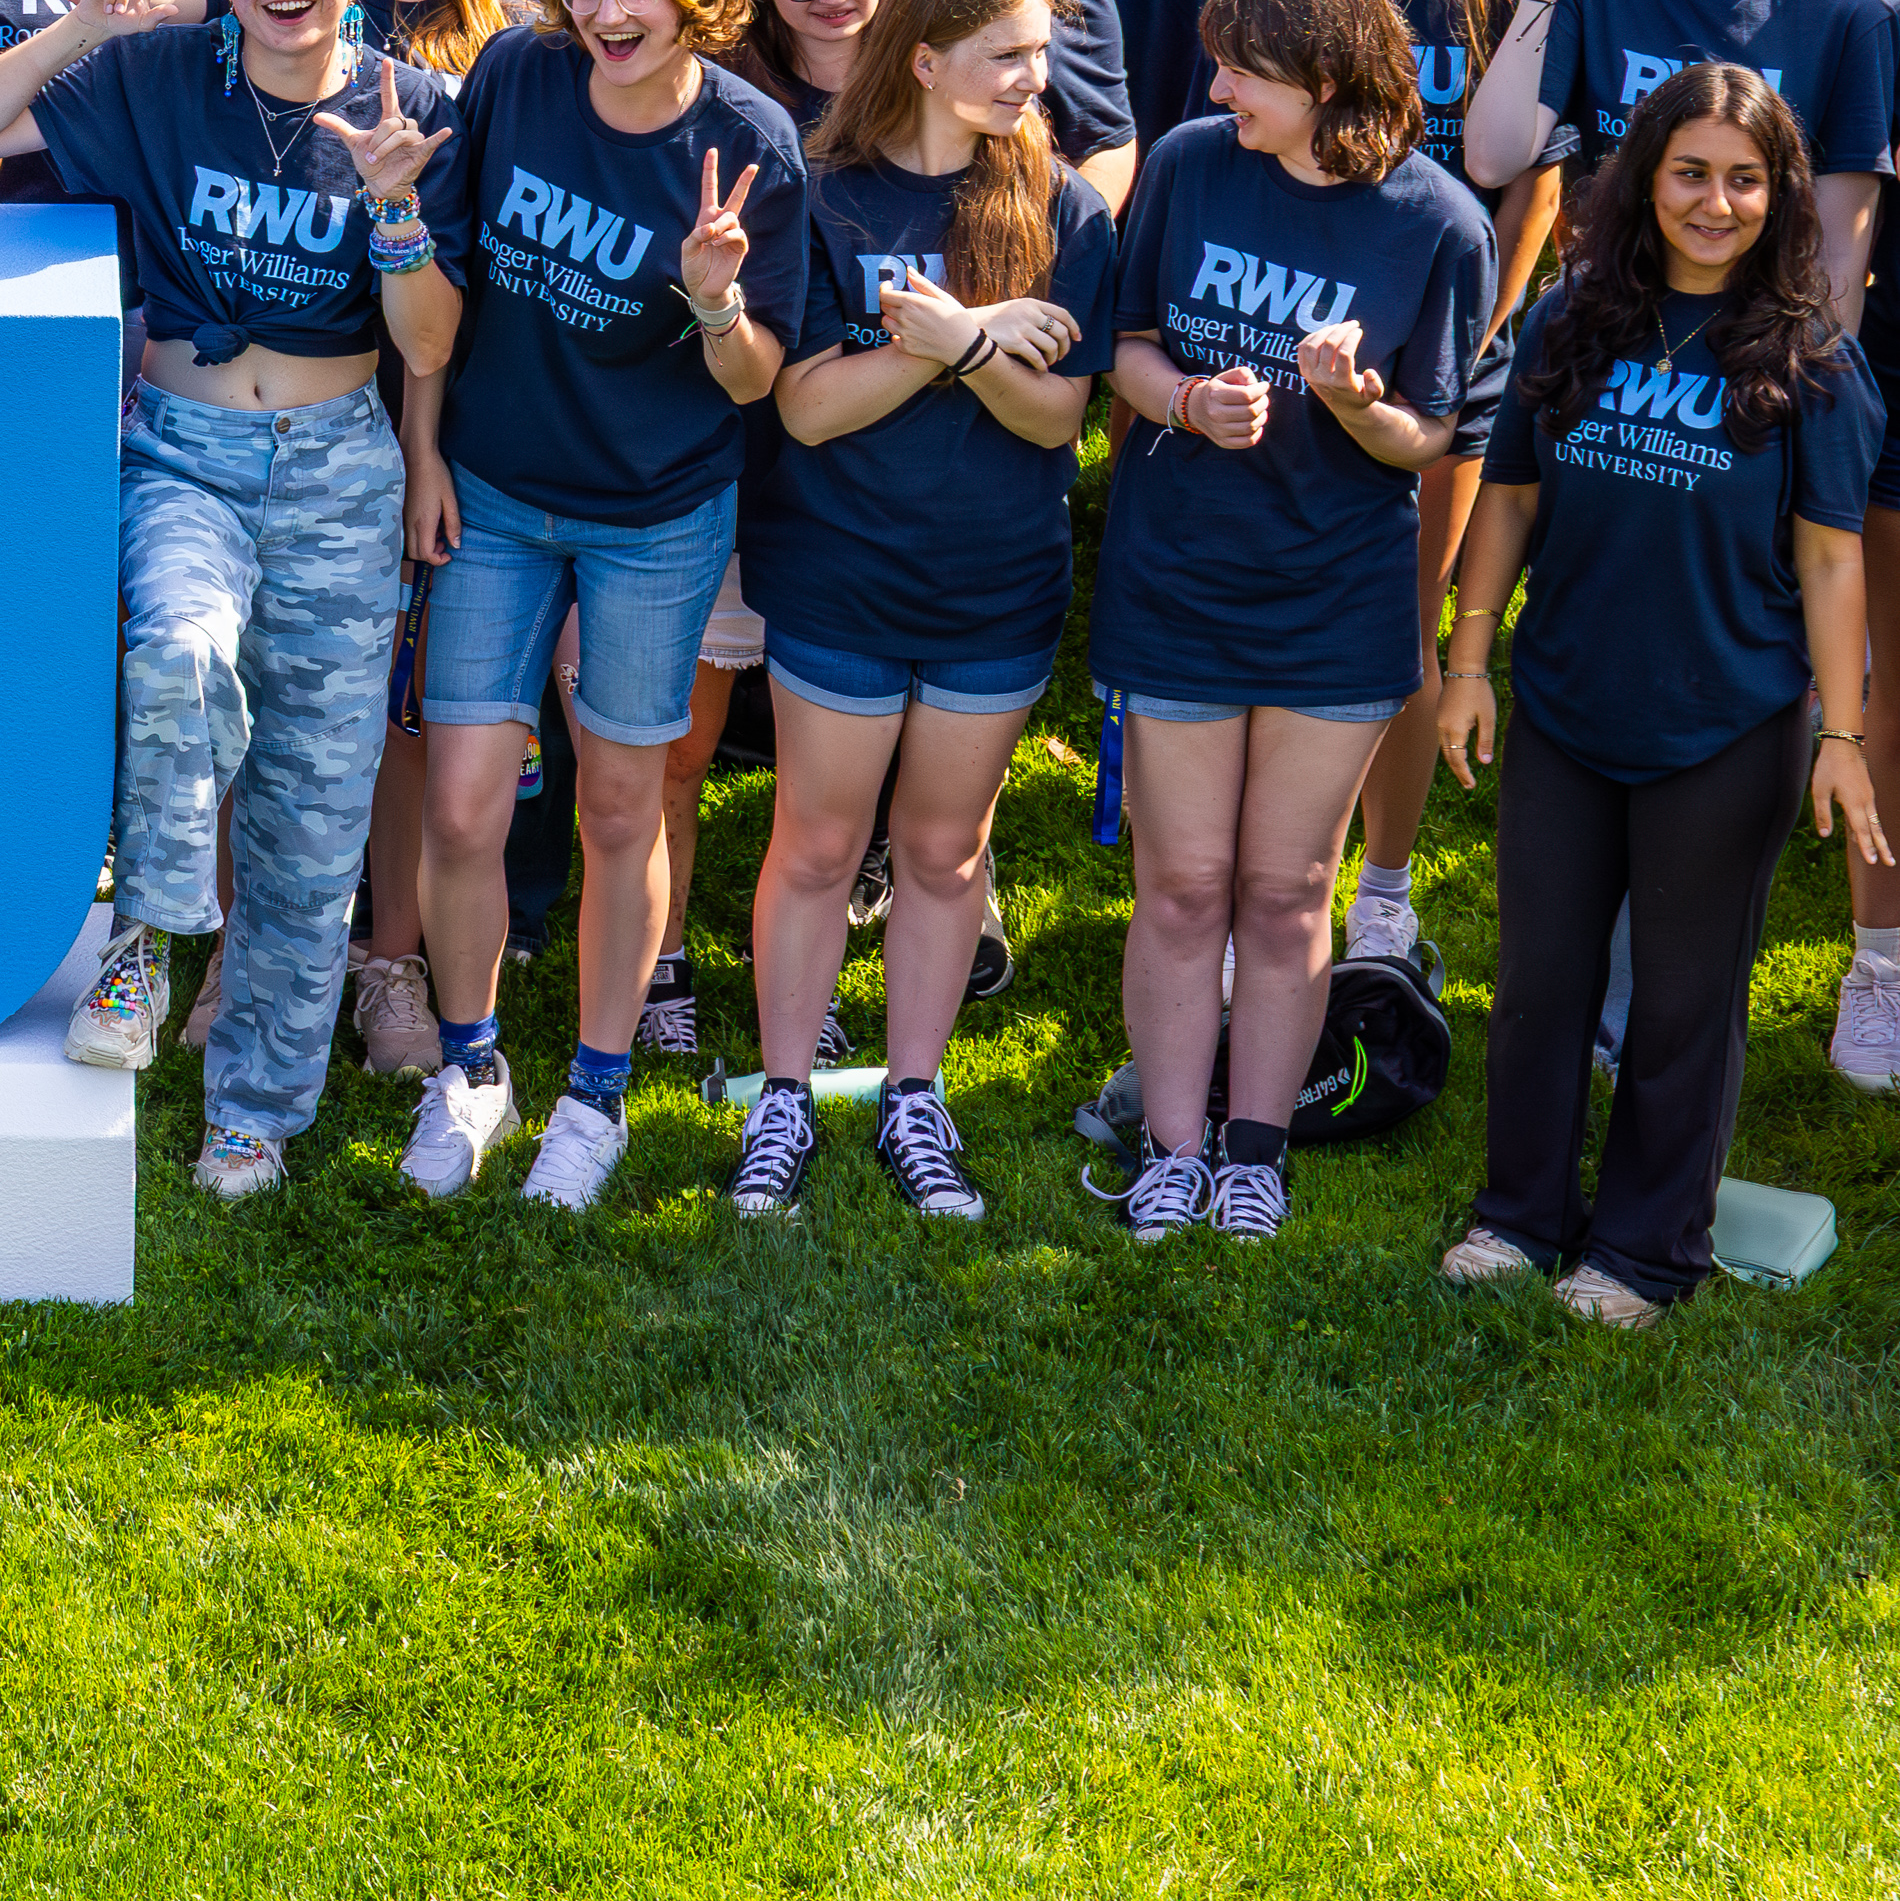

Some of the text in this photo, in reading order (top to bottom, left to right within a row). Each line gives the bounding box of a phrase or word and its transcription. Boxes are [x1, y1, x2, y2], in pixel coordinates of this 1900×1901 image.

[190, 166, 356, 255] RWU
[498, 166, 654, 282] RWU
[212, 272, 318, 308] IVERSITY
[251, 250, 349, 291] Williams
[477, 222, 644, 318] Roger Williams
[487, 264, 613, 334] UNIVERSITY
[1190, 243, 1356, 333] RWU
[1166, 303, 1302, 361] Roger Willia
[1554, 442, 1703, 491] UNIVERSITY
[1569, 416, 1733, 474] ger Williams
